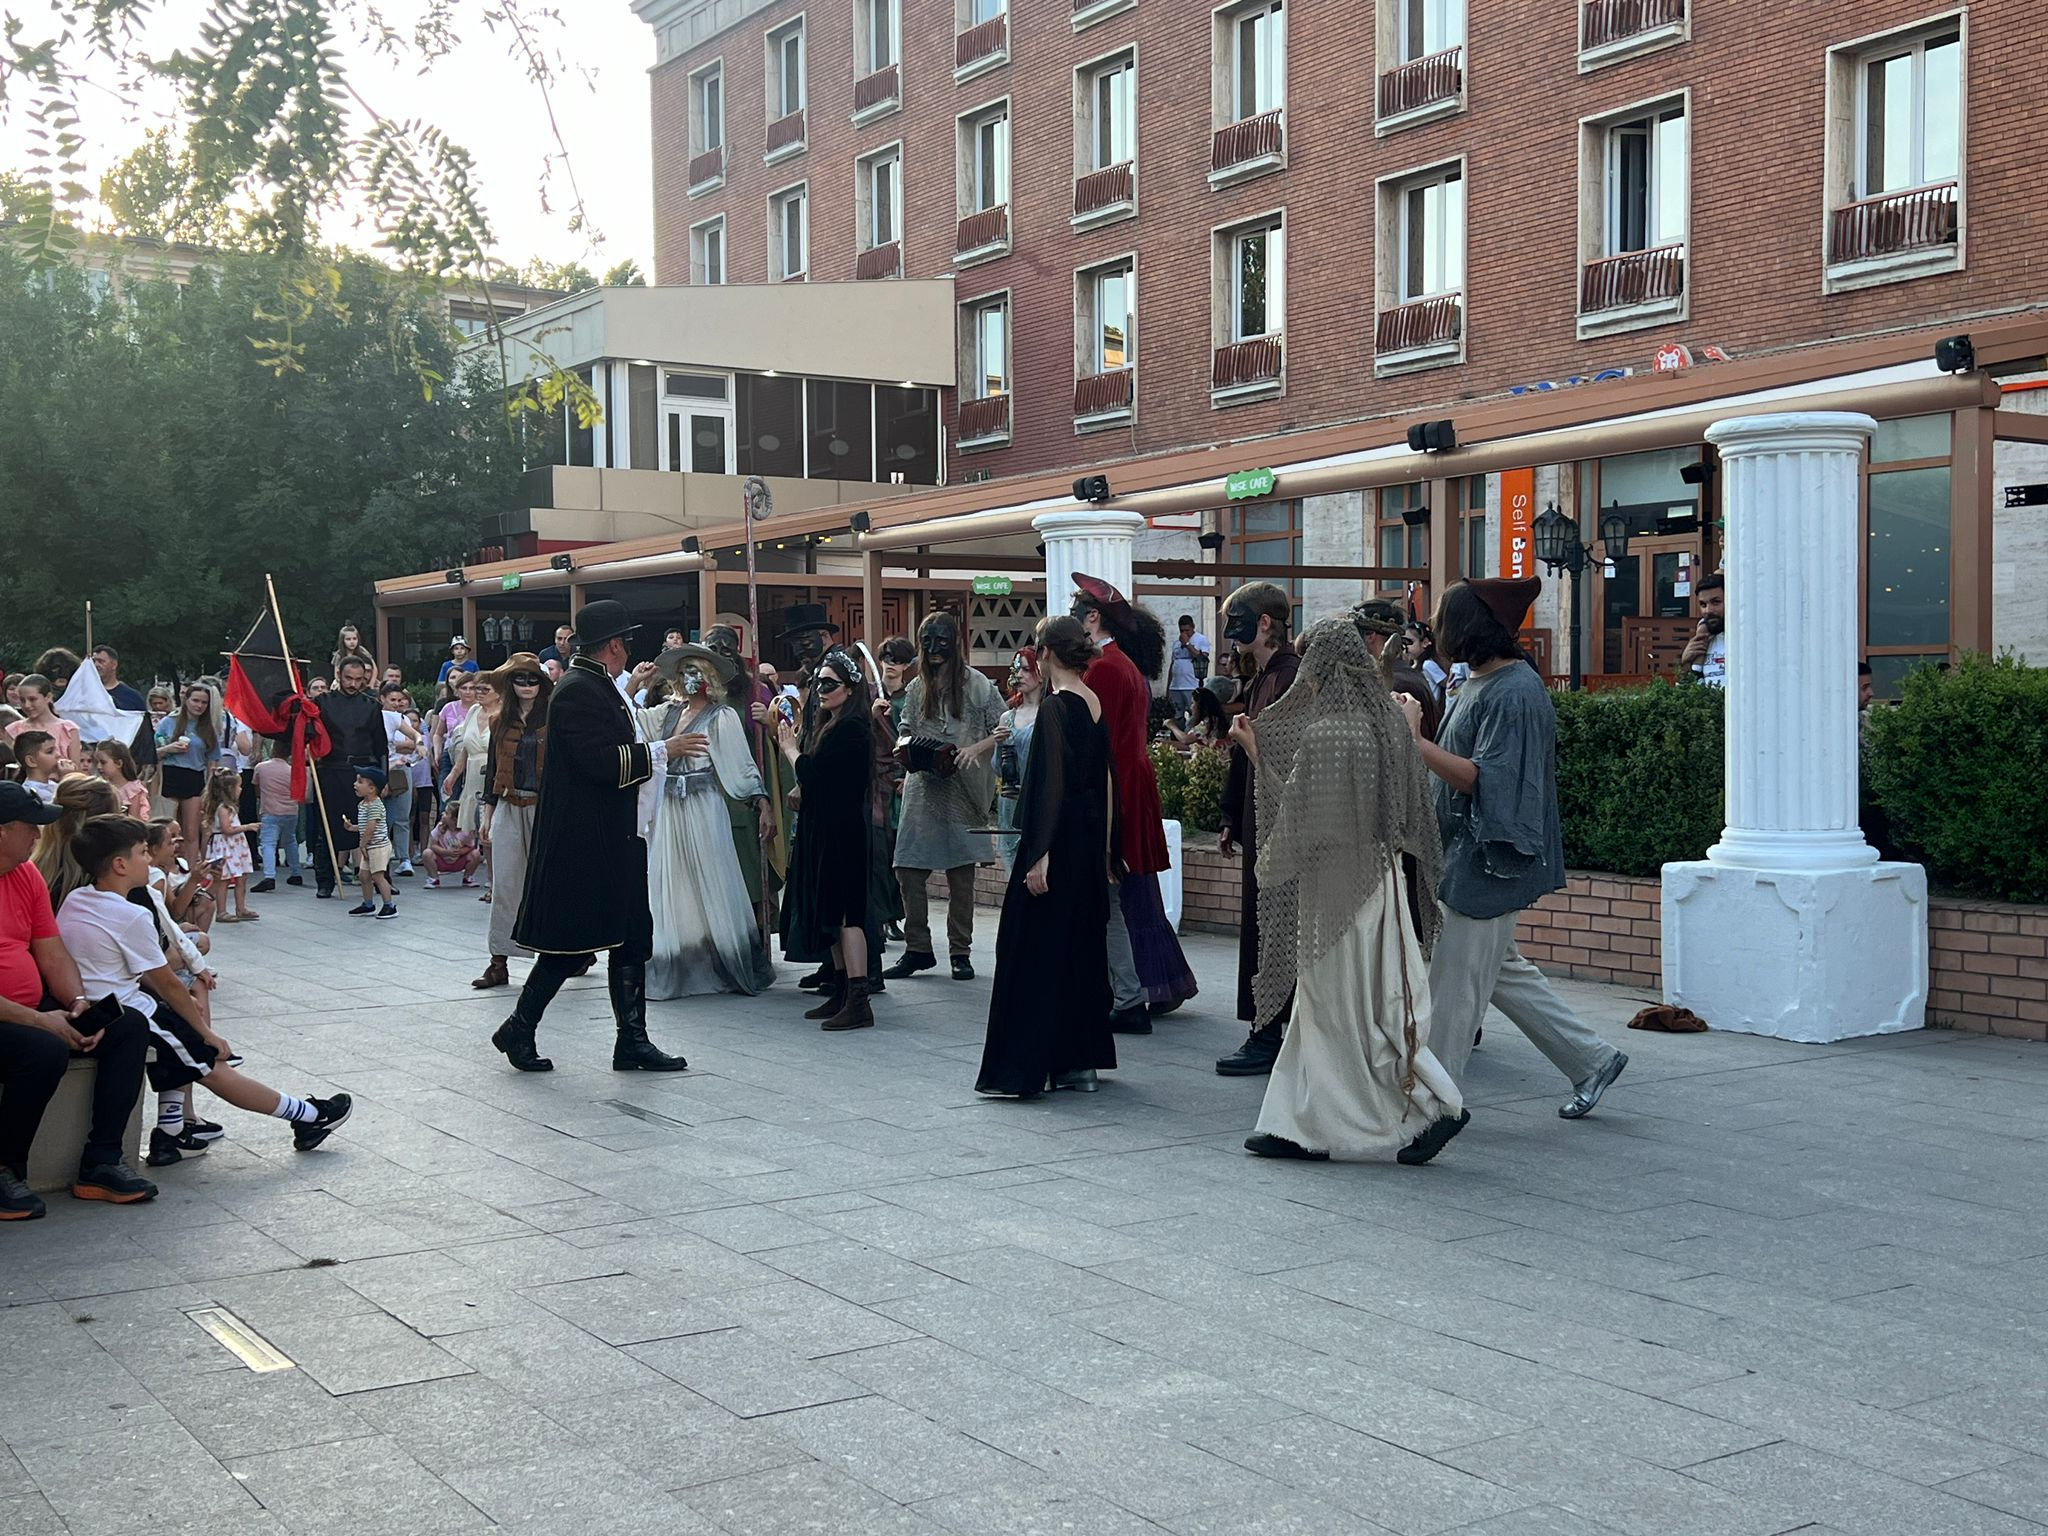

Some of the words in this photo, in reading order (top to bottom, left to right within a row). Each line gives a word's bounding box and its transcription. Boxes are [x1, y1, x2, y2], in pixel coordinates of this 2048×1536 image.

[1250, 476, 1268, 489] CAFE
[1512, 495, 1527, 532] Self
[1512, 537, 1527, 579] Ban
